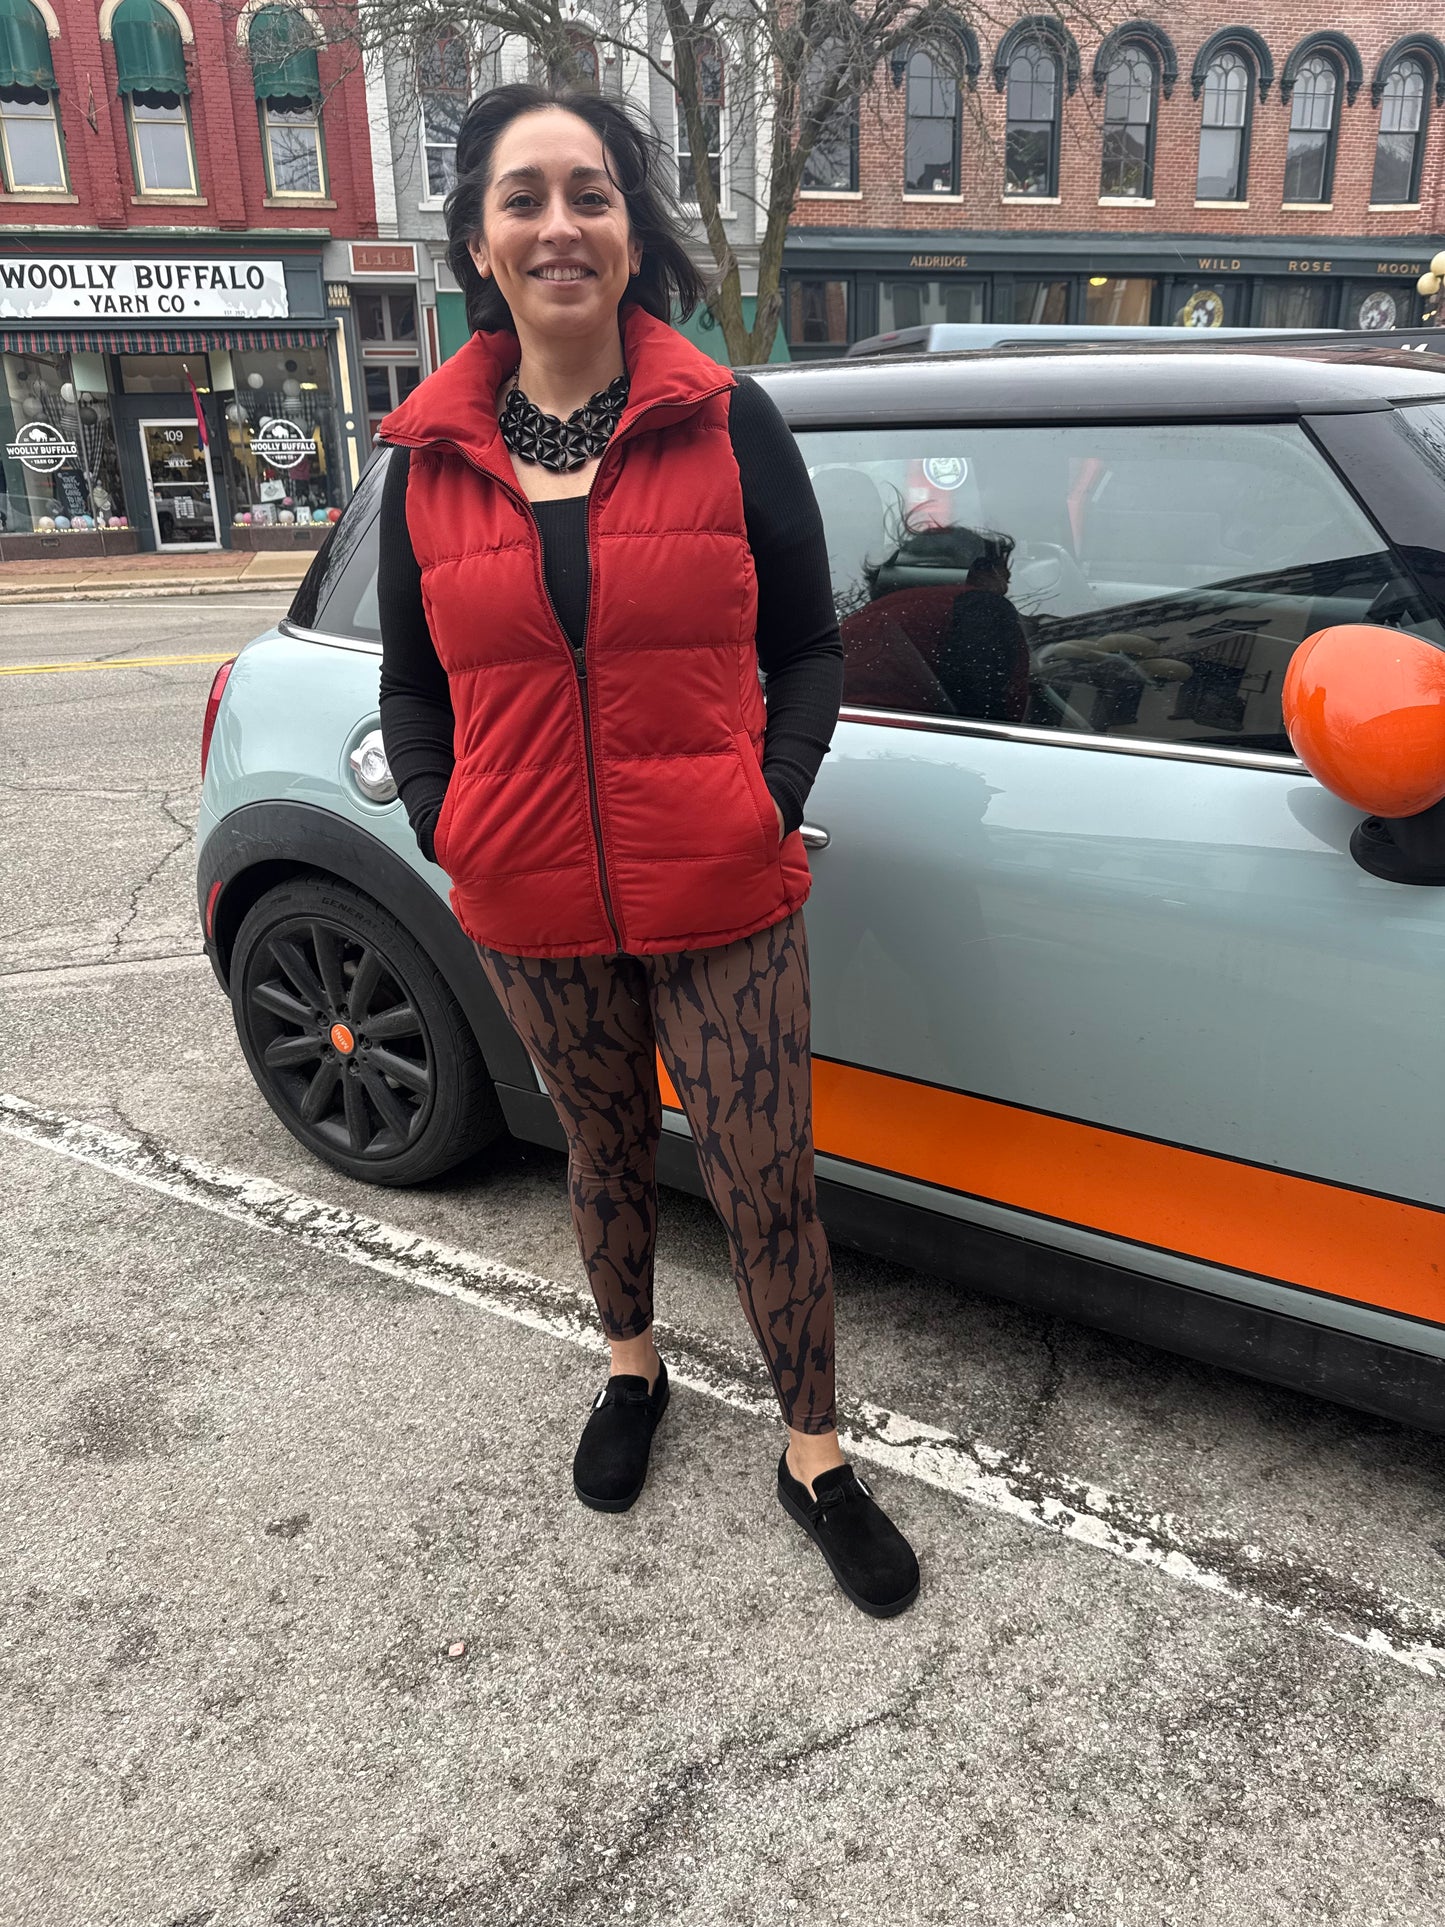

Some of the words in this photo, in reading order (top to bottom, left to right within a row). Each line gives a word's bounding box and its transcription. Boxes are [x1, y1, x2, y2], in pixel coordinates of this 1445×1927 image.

[909, 255, 968, 268] ALDRIDGE
[1198, 258, 1241, 271] WILD
[1288, 260, 1333, 272] ROSE
[1376, 262, 1421, 274] MOON
[0, 264, 117, 289] WOOLLY
[134, 264, 264, 290] BUFFALO
[88, 294, 150, 313] YARN
[157, 294, 185, 313] CO
[163, 430, 183, 442] 109
[6, 446, 39, 456] WOOLLY
[40, 445, 77, 455] BUFFALO
[249, 442, 280, 451] WOOLLY
[281, 442, 316, 450] BUFFALO
[335, 1028, 350, 1050] MINI
